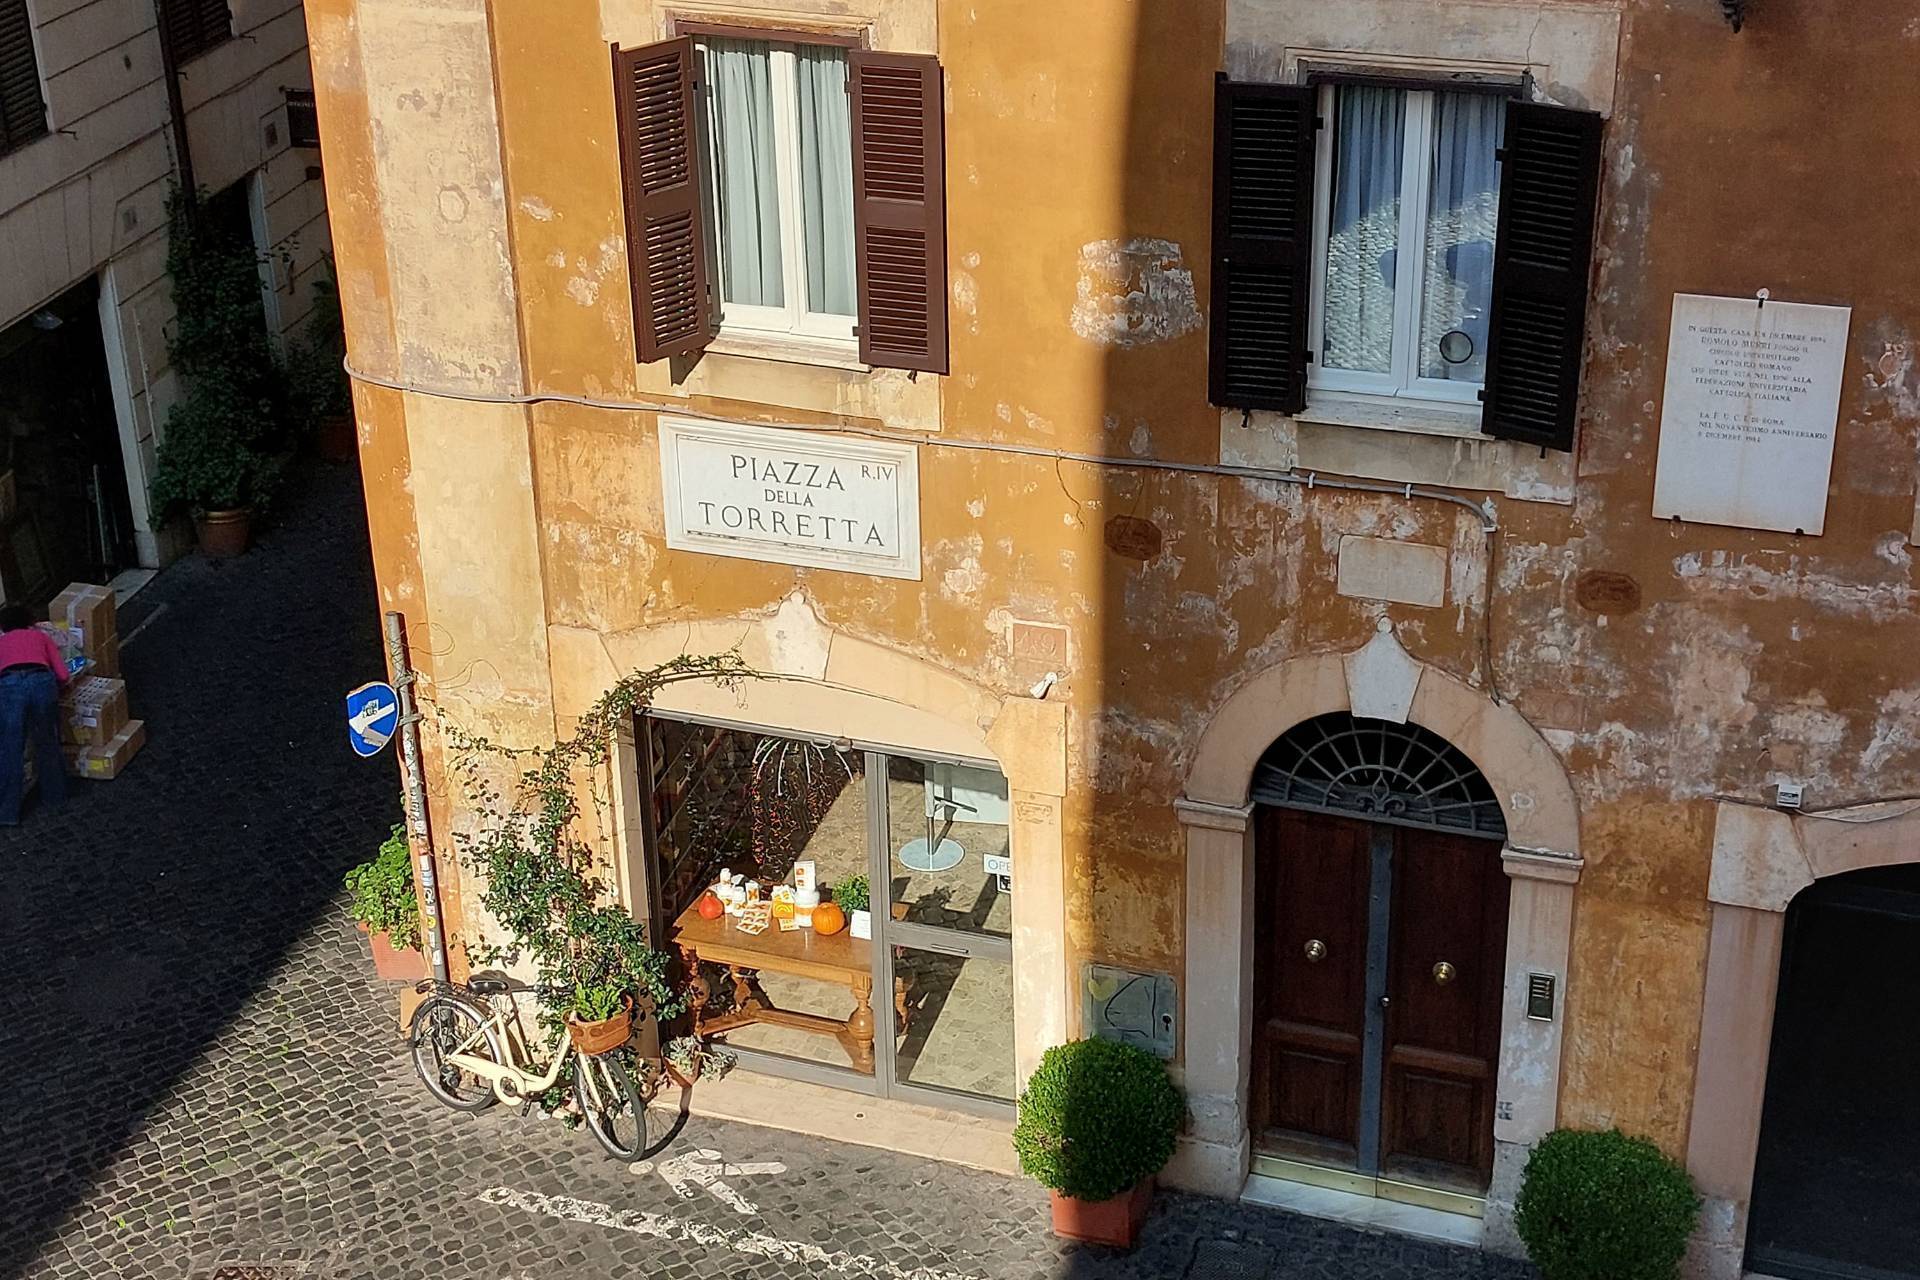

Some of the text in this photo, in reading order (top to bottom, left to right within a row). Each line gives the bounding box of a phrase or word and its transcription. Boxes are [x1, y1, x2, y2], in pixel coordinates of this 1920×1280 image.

[1754, 393, 1791, 402] ITALIANA
[1771, 428, 1828, 440] ANNIVERSARIO
[730, 454, 845, 491] PIAZZA
[861, 464, 893, 481] R.IV
[764, 488, 814, 507] DELLA
[698, 501, 885, 547] TORRETTA
